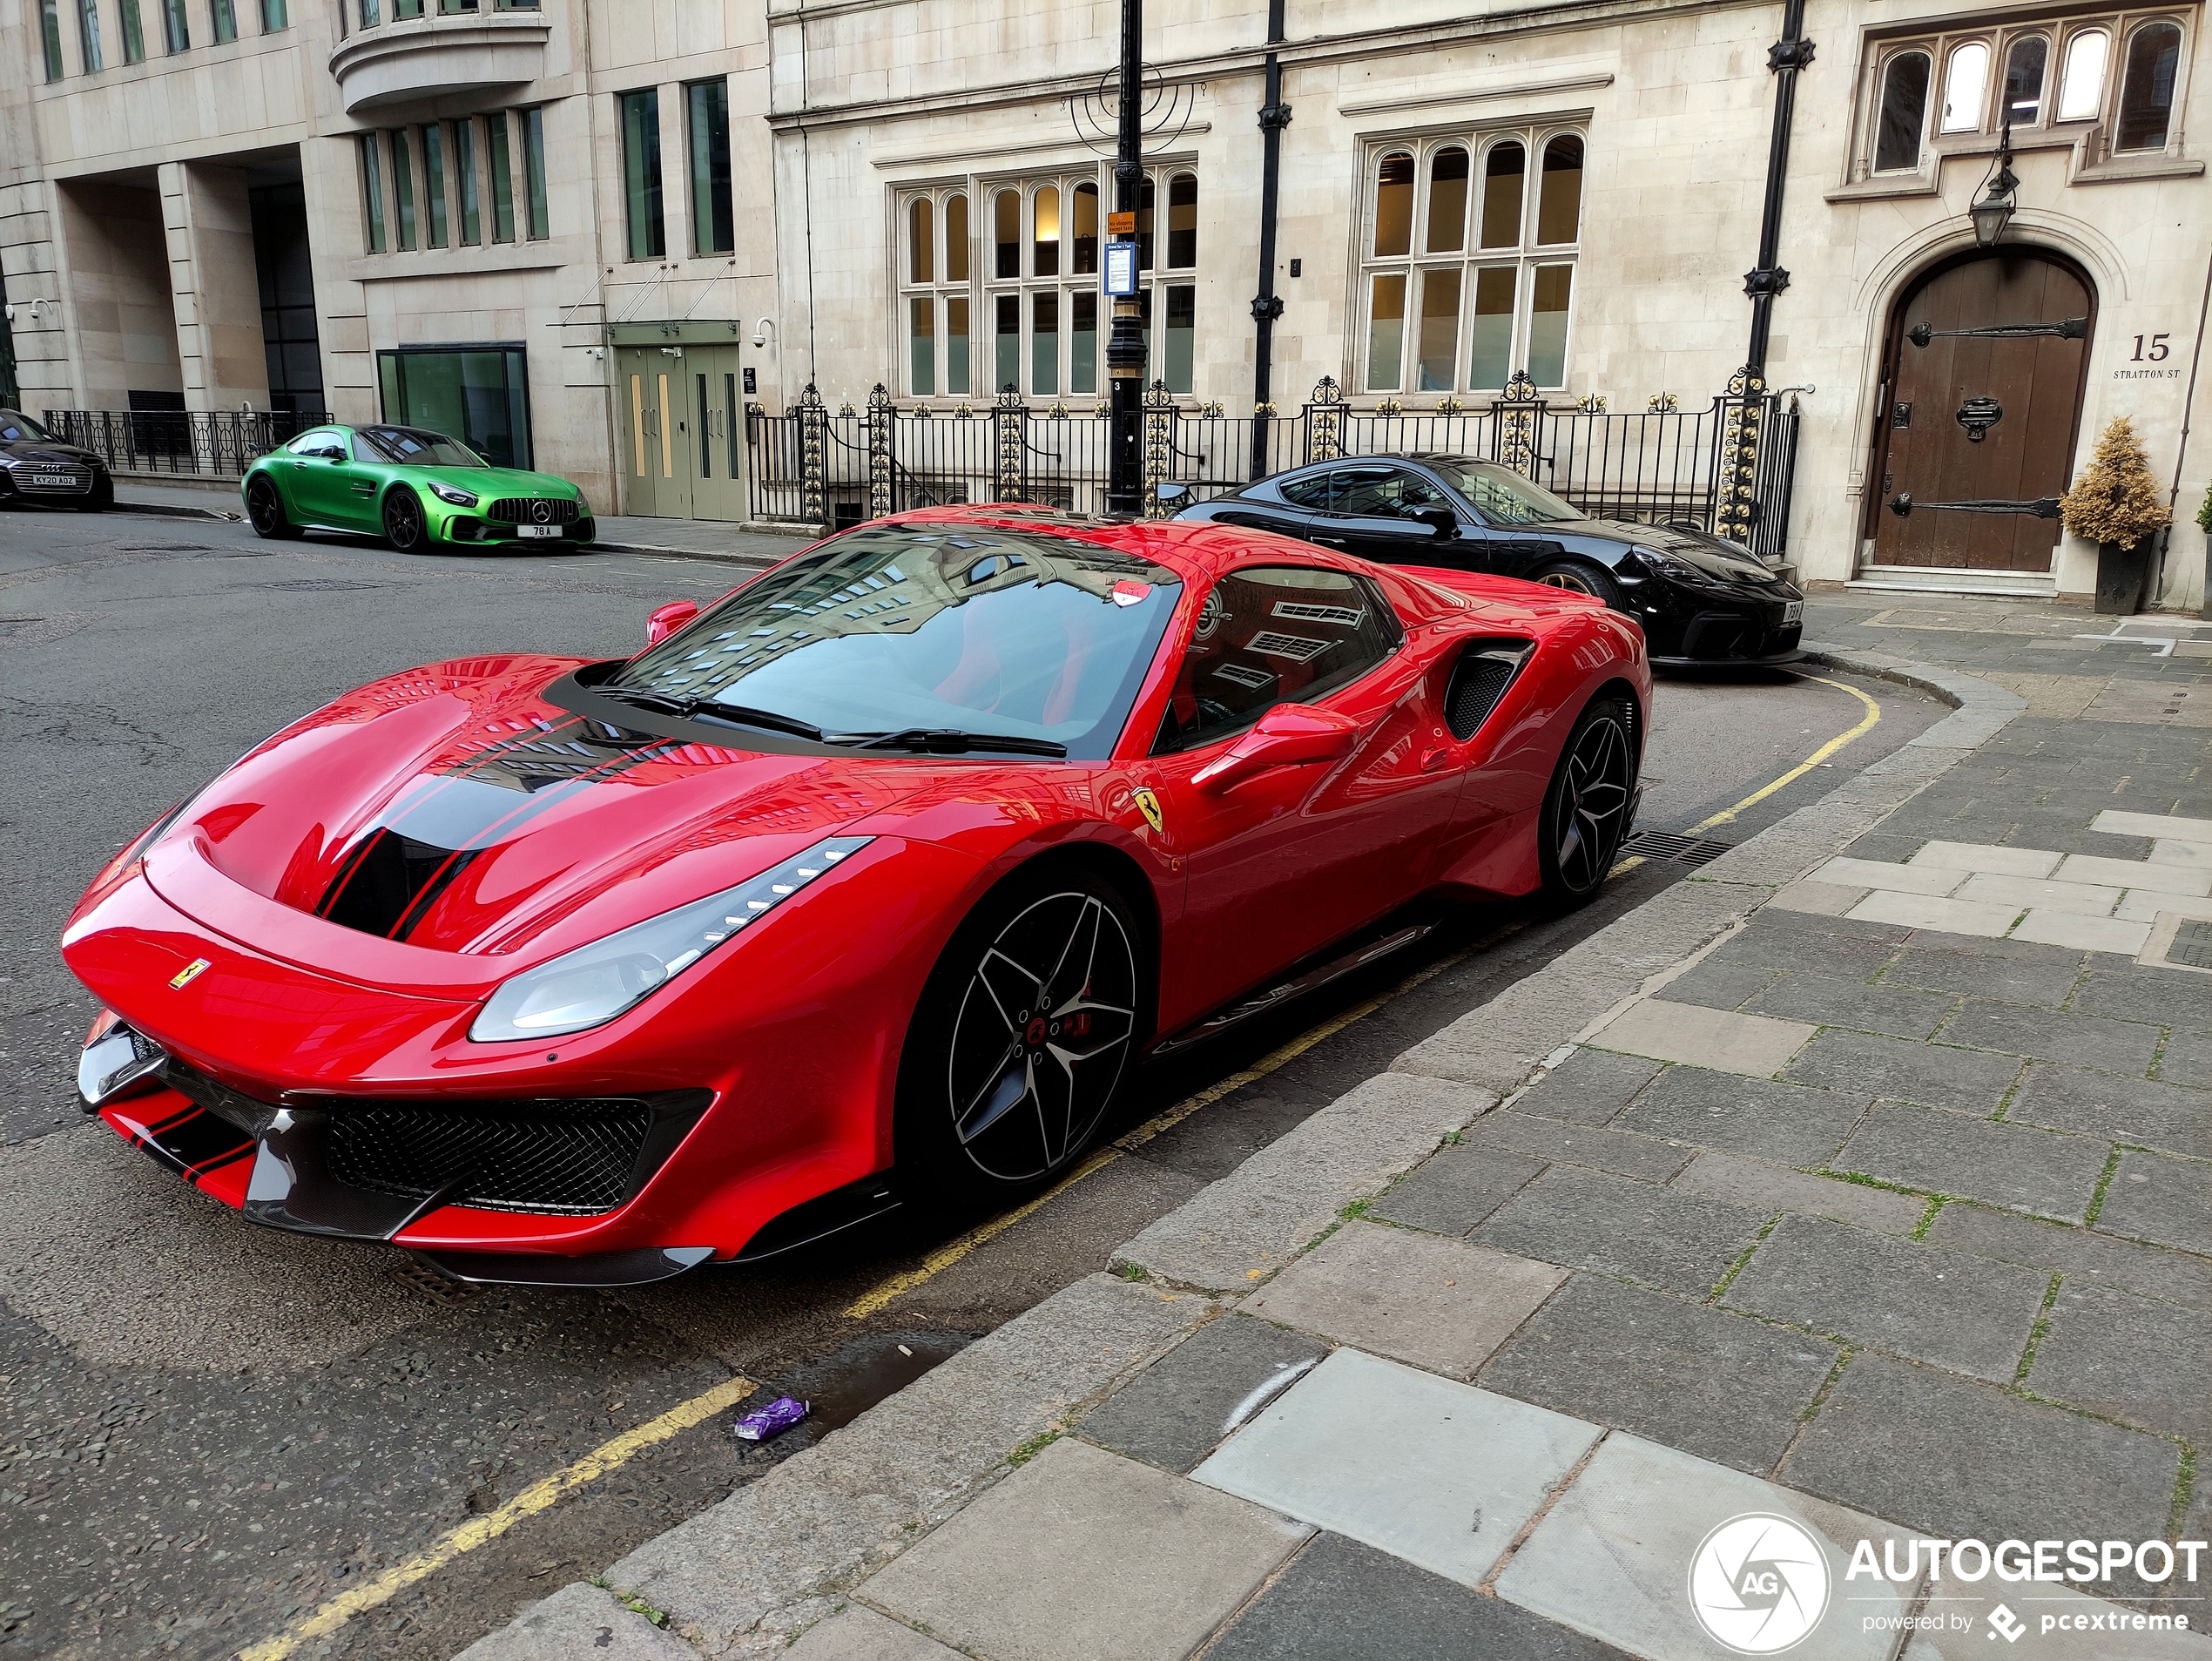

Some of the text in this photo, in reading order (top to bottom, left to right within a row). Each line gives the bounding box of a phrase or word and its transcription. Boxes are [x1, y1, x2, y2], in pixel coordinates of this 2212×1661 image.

[2130, 333, 2170, 361] 15
[2114, 369, 2181, 380] STRATTON ST
[1115, 381, 1121, 391] 3
[533, 526, 551, 536] 78 A
